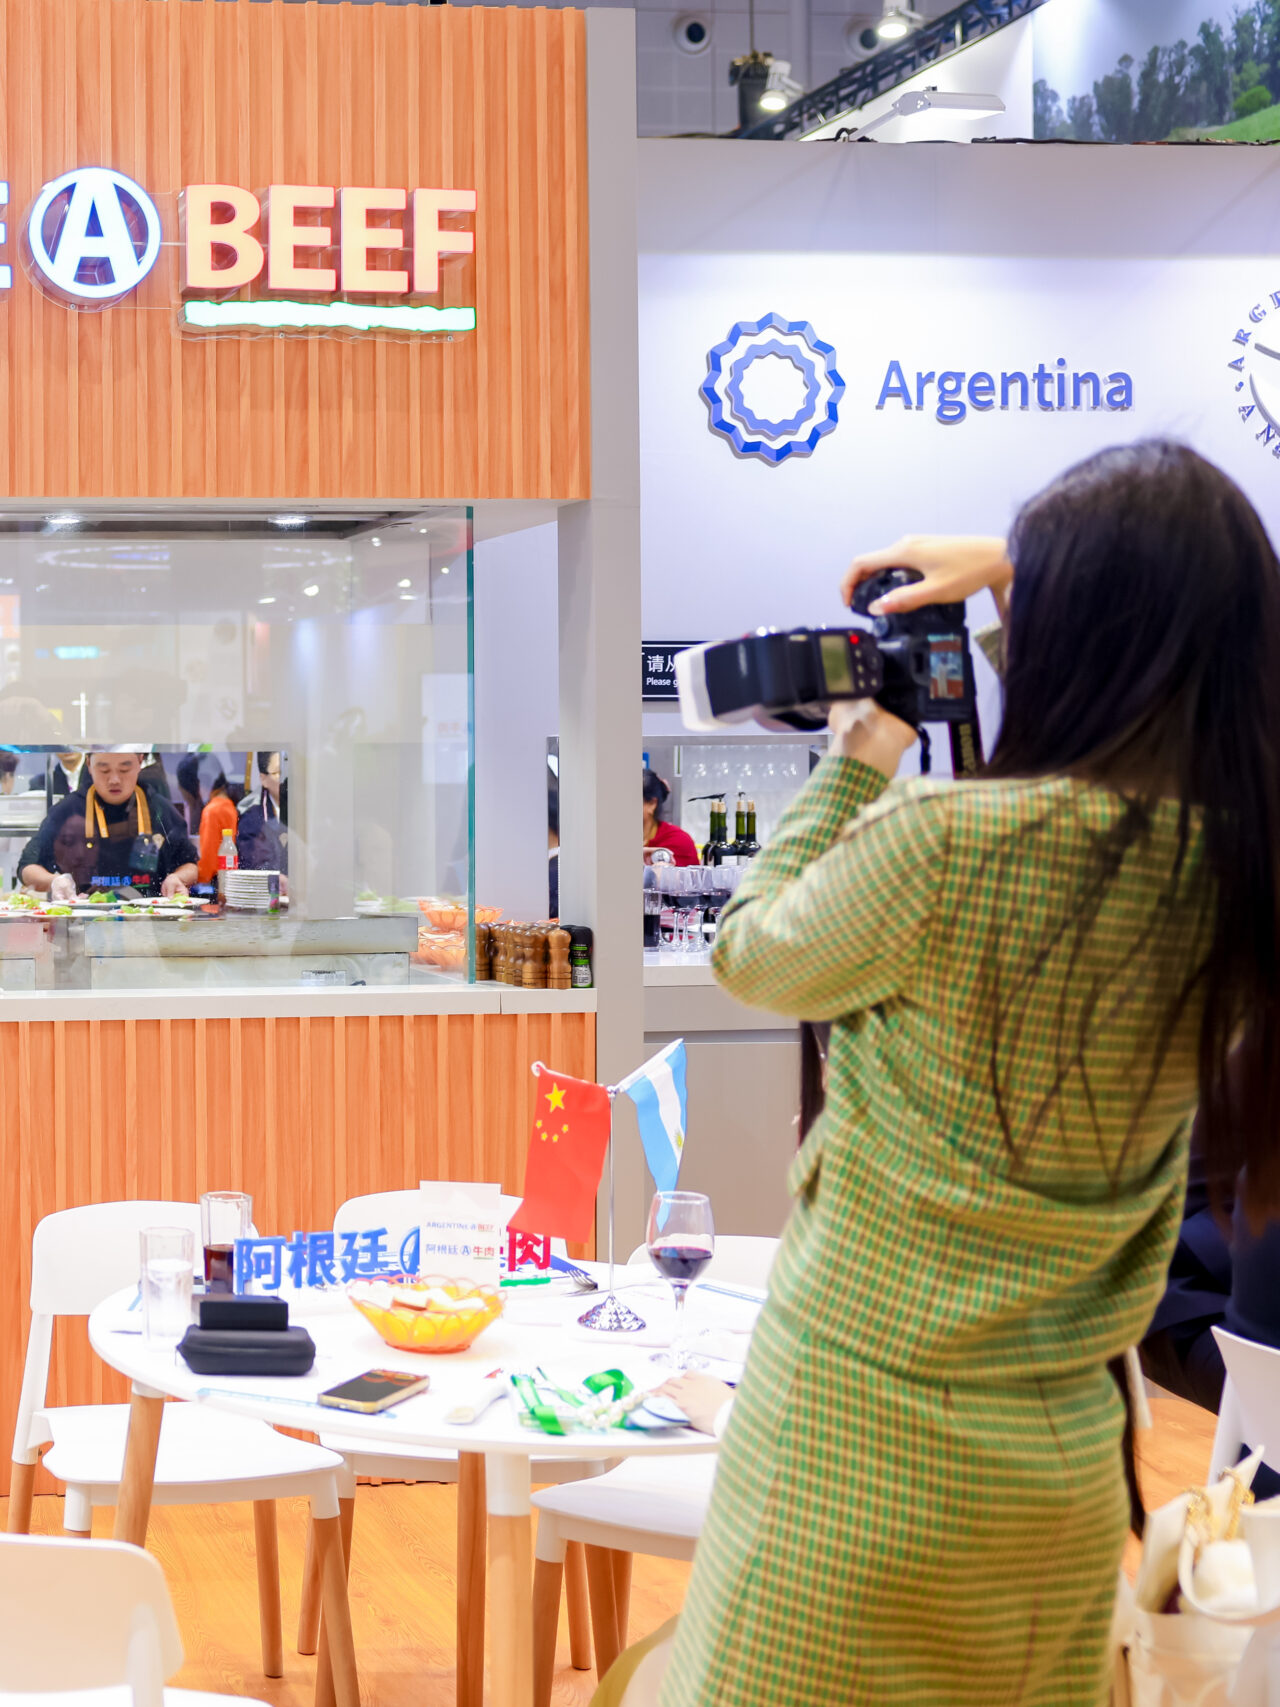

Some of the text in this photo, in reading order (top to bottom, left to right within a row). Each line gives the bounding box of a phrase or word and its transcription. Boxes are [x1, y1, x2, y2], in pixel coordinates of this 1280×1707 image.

[184, 183, 477, 293] BEEF
[876, 357, 1133, 424] Argentina
[646, 677, 671, 686] Please
[233, 1228, 388, 1294] 阿根廷
[500, 1225, 550, 1272] 肉
